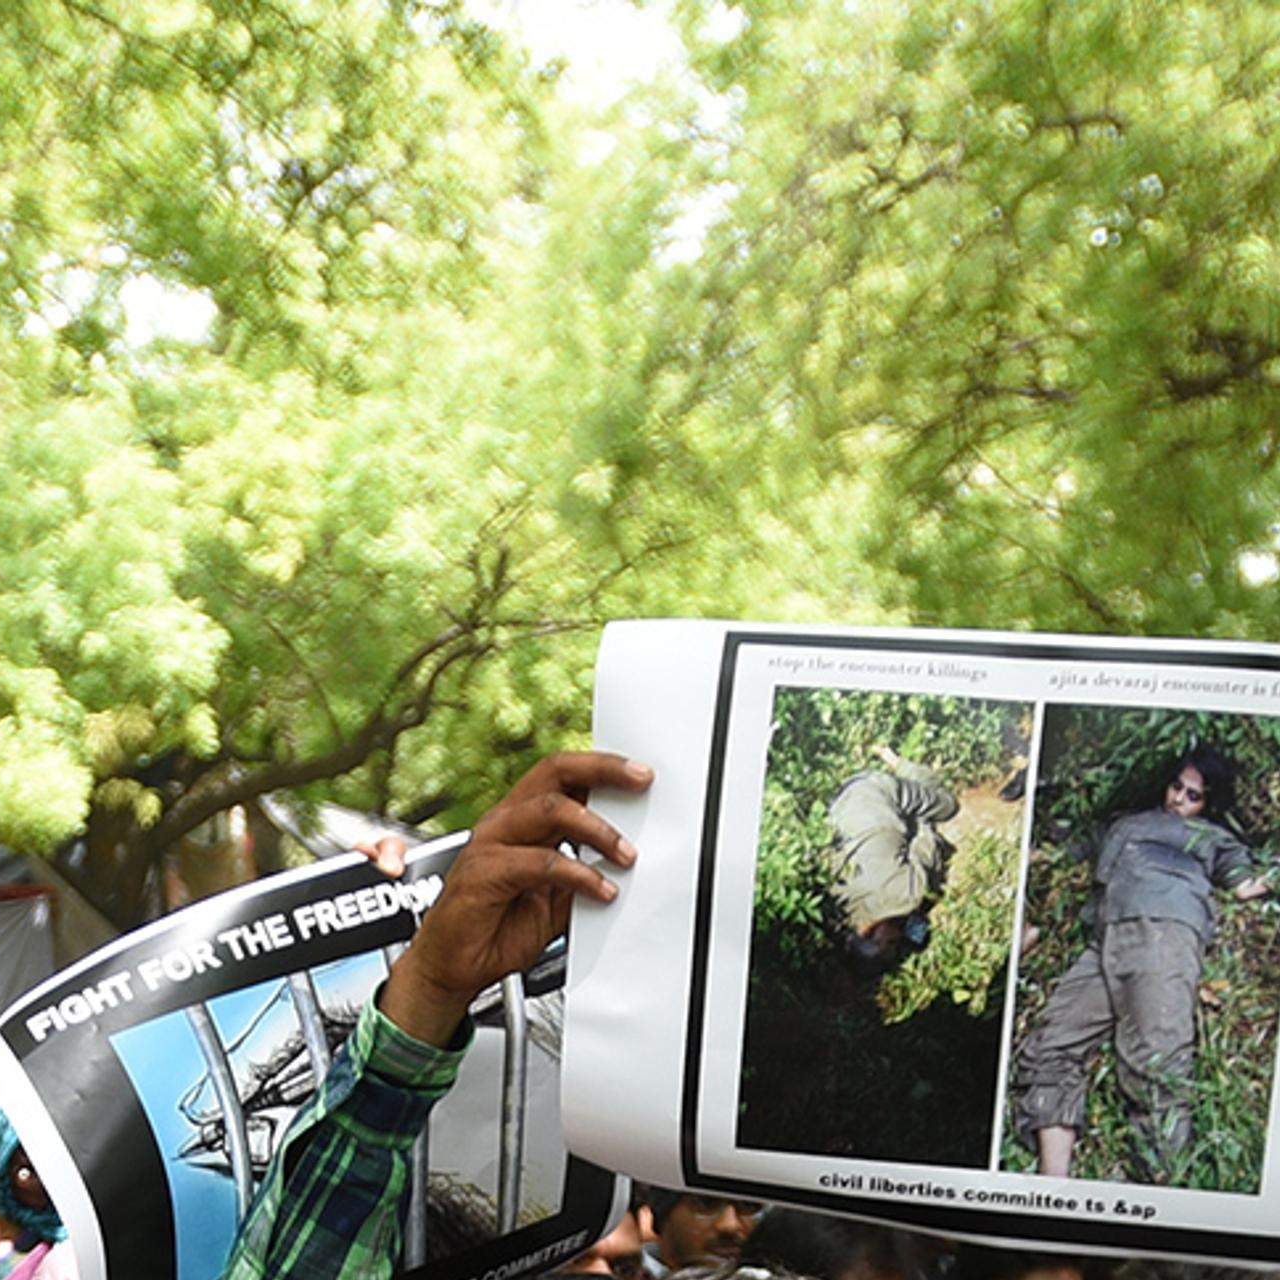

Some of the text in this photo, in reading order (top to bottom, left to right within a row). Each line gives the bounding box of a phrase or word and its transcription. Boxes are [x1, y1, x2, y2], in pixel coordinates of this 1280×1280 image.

[768, 656, 989, 683] stop the encounter killings
[1049, 671, 1088, 690] ajita
[1093, 671, 1159, 693] devaraj
[1162, 677, 1248, 696] encounter
[1252, 682, 1267, 697] is
[26, 972, 136, 1042] FIGHT
[139, 941, 223, 991] FOR
[217, 915, 294, 962] THE
[819, 1173, 1157, 1221] civil liberties committee ts &ap
